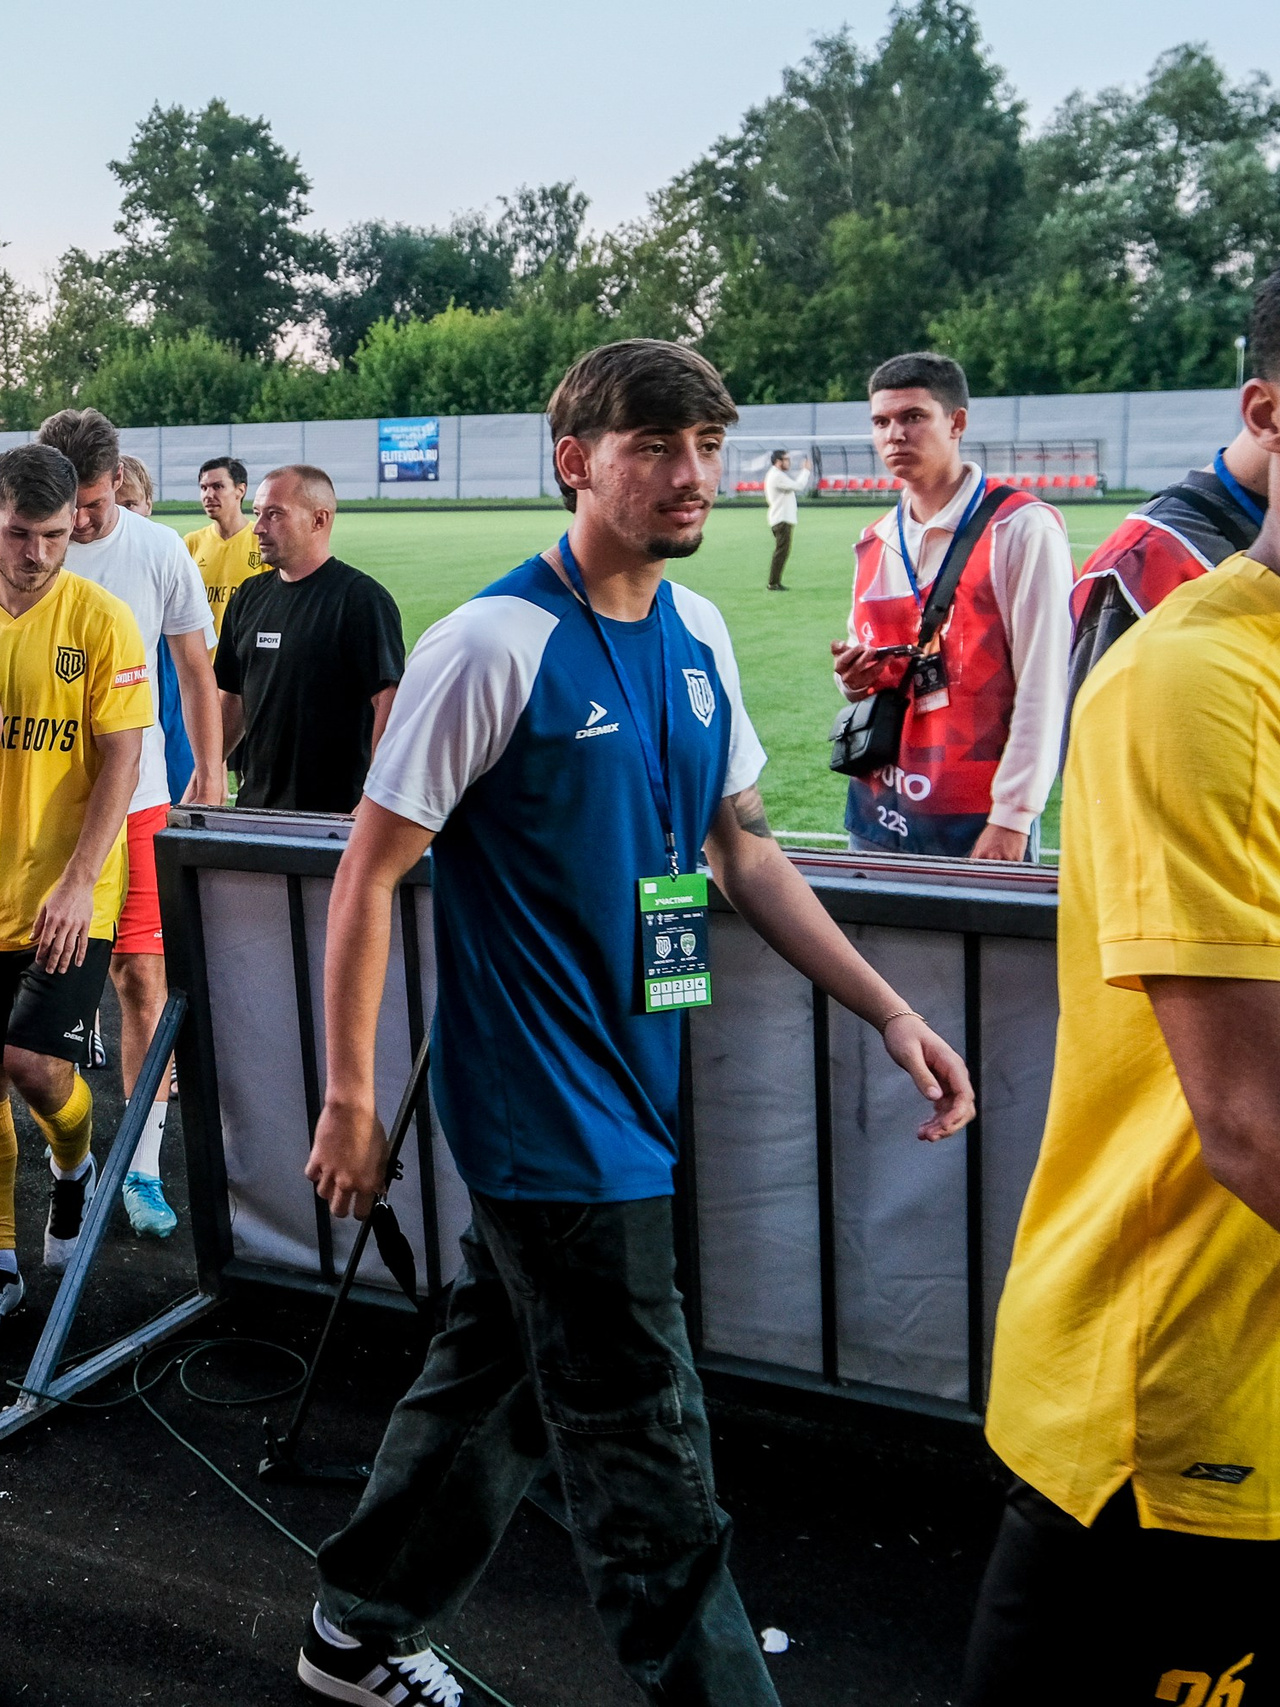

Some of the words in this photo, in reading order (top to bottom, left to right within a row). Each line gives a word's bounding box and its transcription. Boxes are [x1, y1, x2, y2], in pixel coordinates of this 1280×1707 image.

[205, 586, 228, 603] OKE
[22, 717, 79, 752] BOYS
[575, 722, 620, 740] DEMIX
[877, 805, 909, 837] 225
[652, 985, 658, 993] 0
[675, 982, 680, 990] 2
[687, 981, 692, 989] 3
[697, 979, 703, 987] 4
